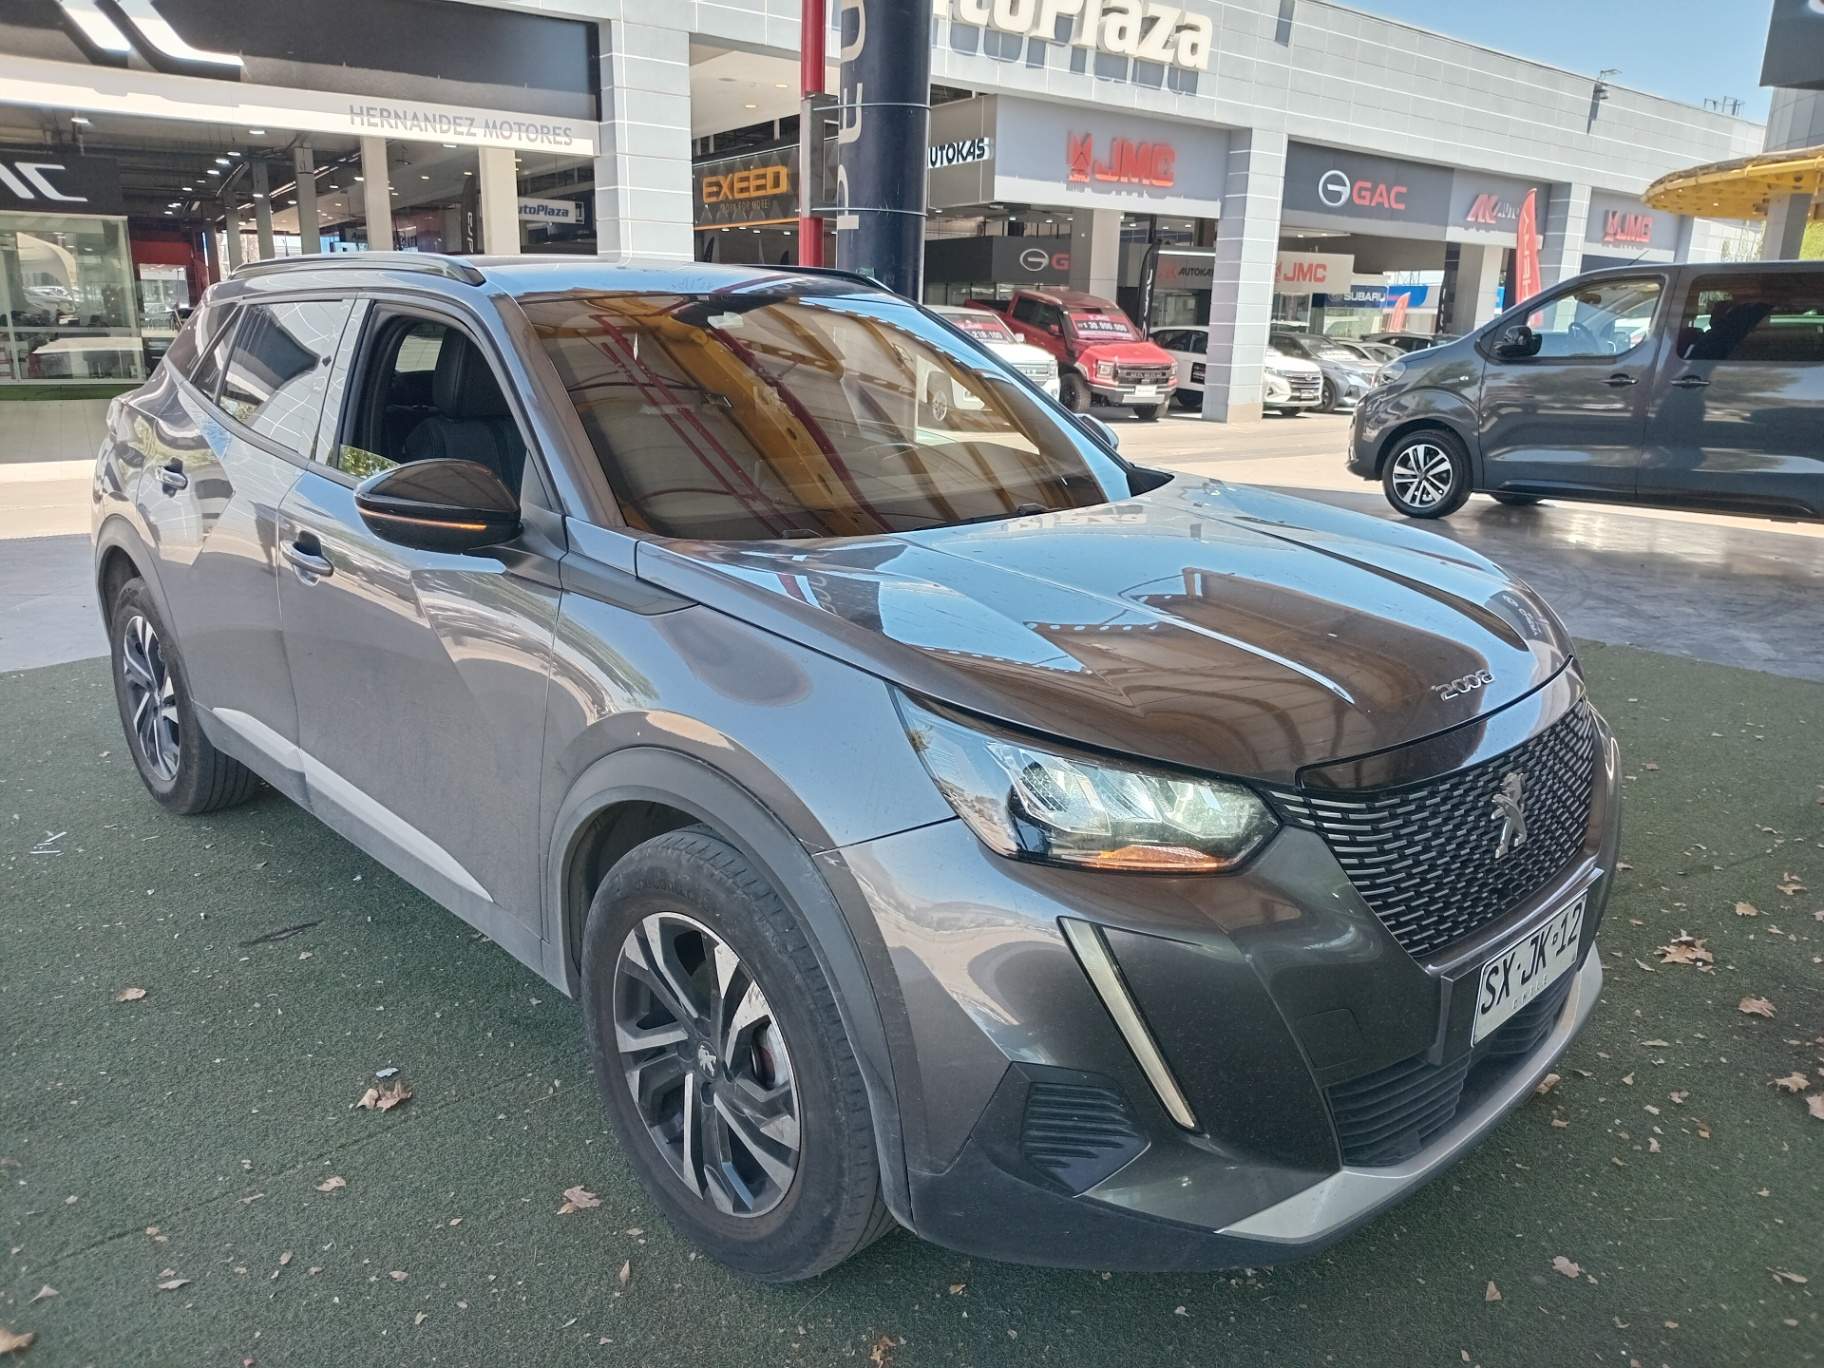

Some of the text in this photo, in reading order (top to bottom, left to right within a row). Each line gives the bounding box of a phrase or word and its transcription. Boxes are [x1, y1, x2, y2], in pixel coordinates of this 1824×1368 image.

[349, 104, 573, 146] HERNANDEZ MOTORES
[1095, 138, 1175, 187] JMC
[703, 166, 788, 203] EXEED
[1352, 180, 1408, 210] GAC
[1283, 262, 1327, 283] JMC
[1343, 291, 1386, 302] SUBARU
[1431, 669, 1494, 701] 2008
